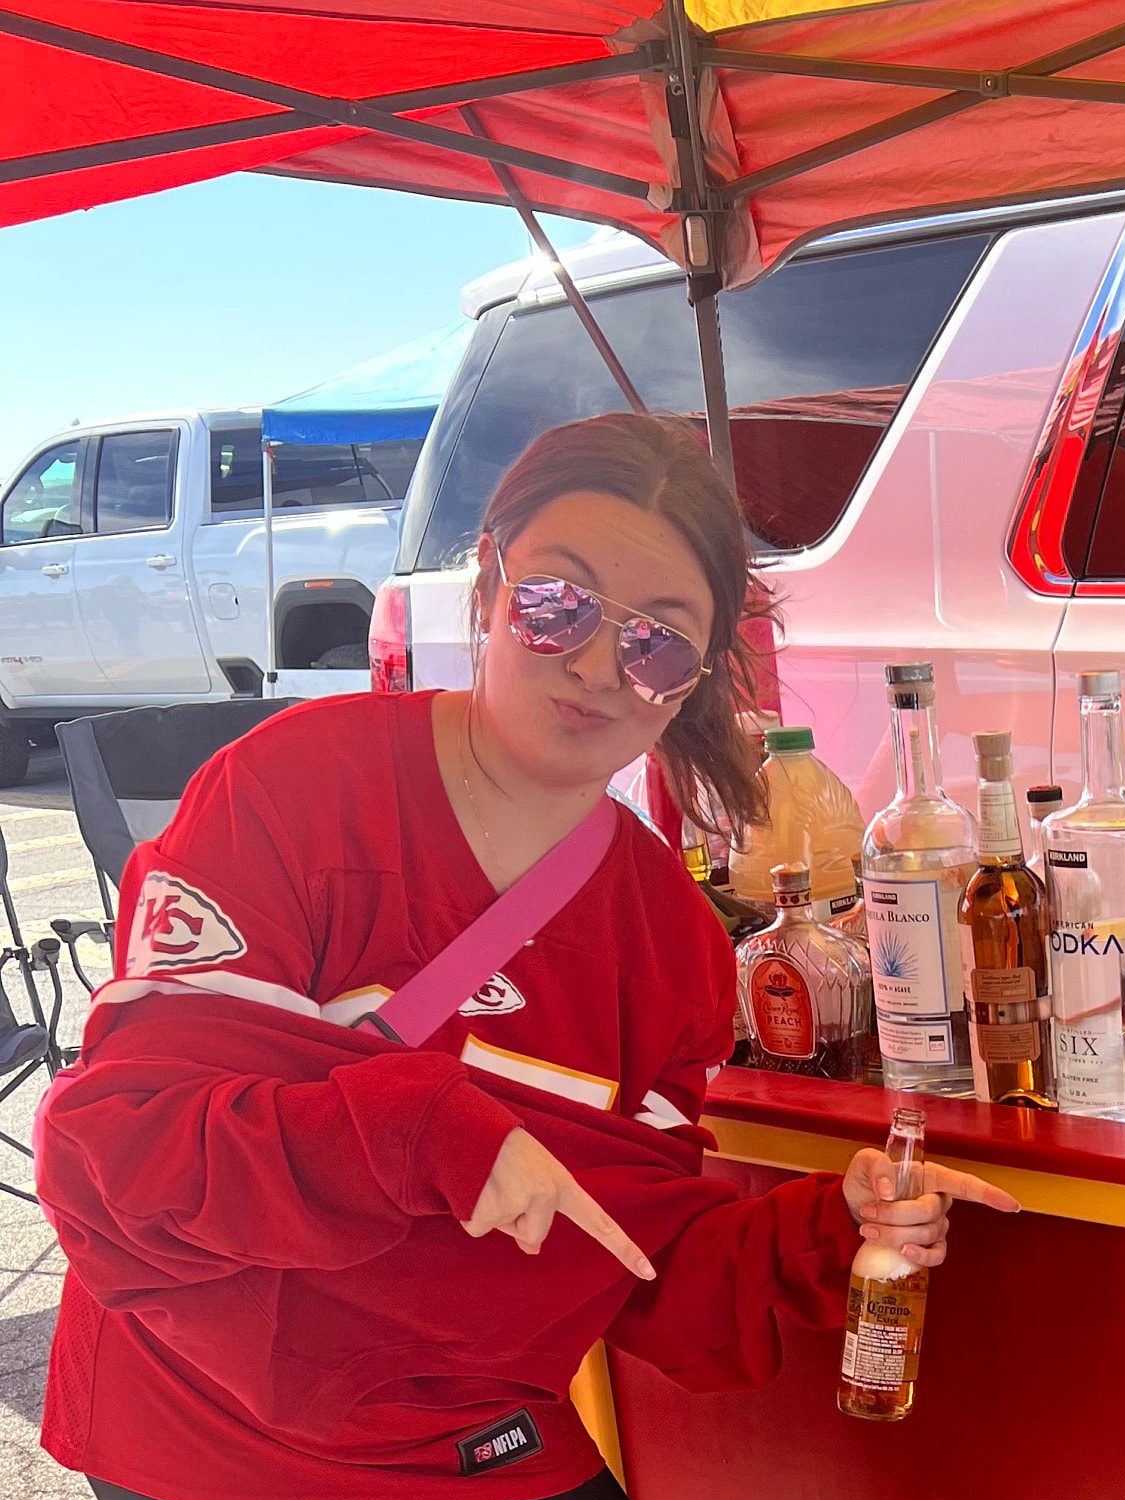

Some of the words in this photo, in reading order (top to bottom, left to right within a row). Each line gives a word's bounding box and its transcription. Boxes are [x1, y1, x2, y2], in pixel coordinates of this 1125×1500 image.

[1049, 851, 1086, 863] KIRKLAND
[887, 910, 930, 922] BLANCO
[141, 895, 204, 955] KC
[1052, 920, 1094, 930] ERICAN
[1051, 931, 1125, 955] ODKA
[766, 1015, 802, 1027] PEACH
[1059, 1033, 1099, 1056] SIX
[491, 1426, 528, 1457] NFLPA
